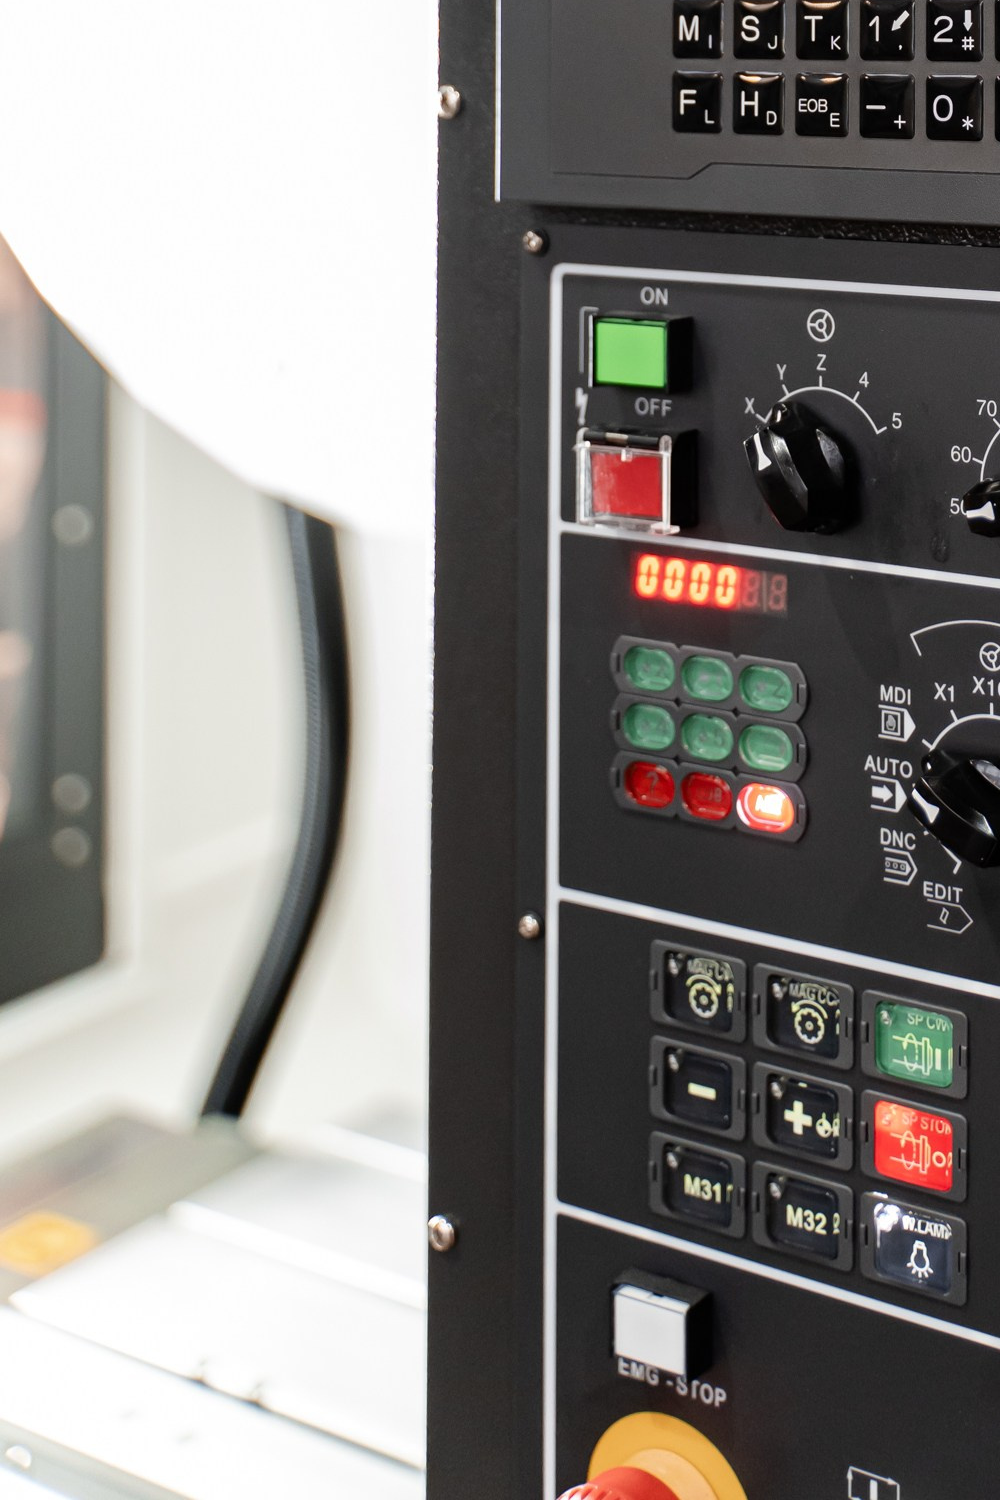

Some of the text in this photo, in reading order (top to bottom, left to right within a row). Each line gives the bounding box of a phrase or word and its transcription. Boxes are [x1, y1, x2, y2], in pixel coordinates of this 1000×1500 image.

[798, 98, 828, 113] EOB
[640, 286, 668, 306] ON
[634, 396, 672, 416] OFF
[977, 399, 997, 417] 70
[950, 445, 971, 463] 60
[880, 685, 911, 704] MDI
[864, 755, 913, 778] AUTO
[880, 828, 916, 850] DNC
[923, 881, 963, 903] EDIT
[786, 1204, 827, 1235] M32
